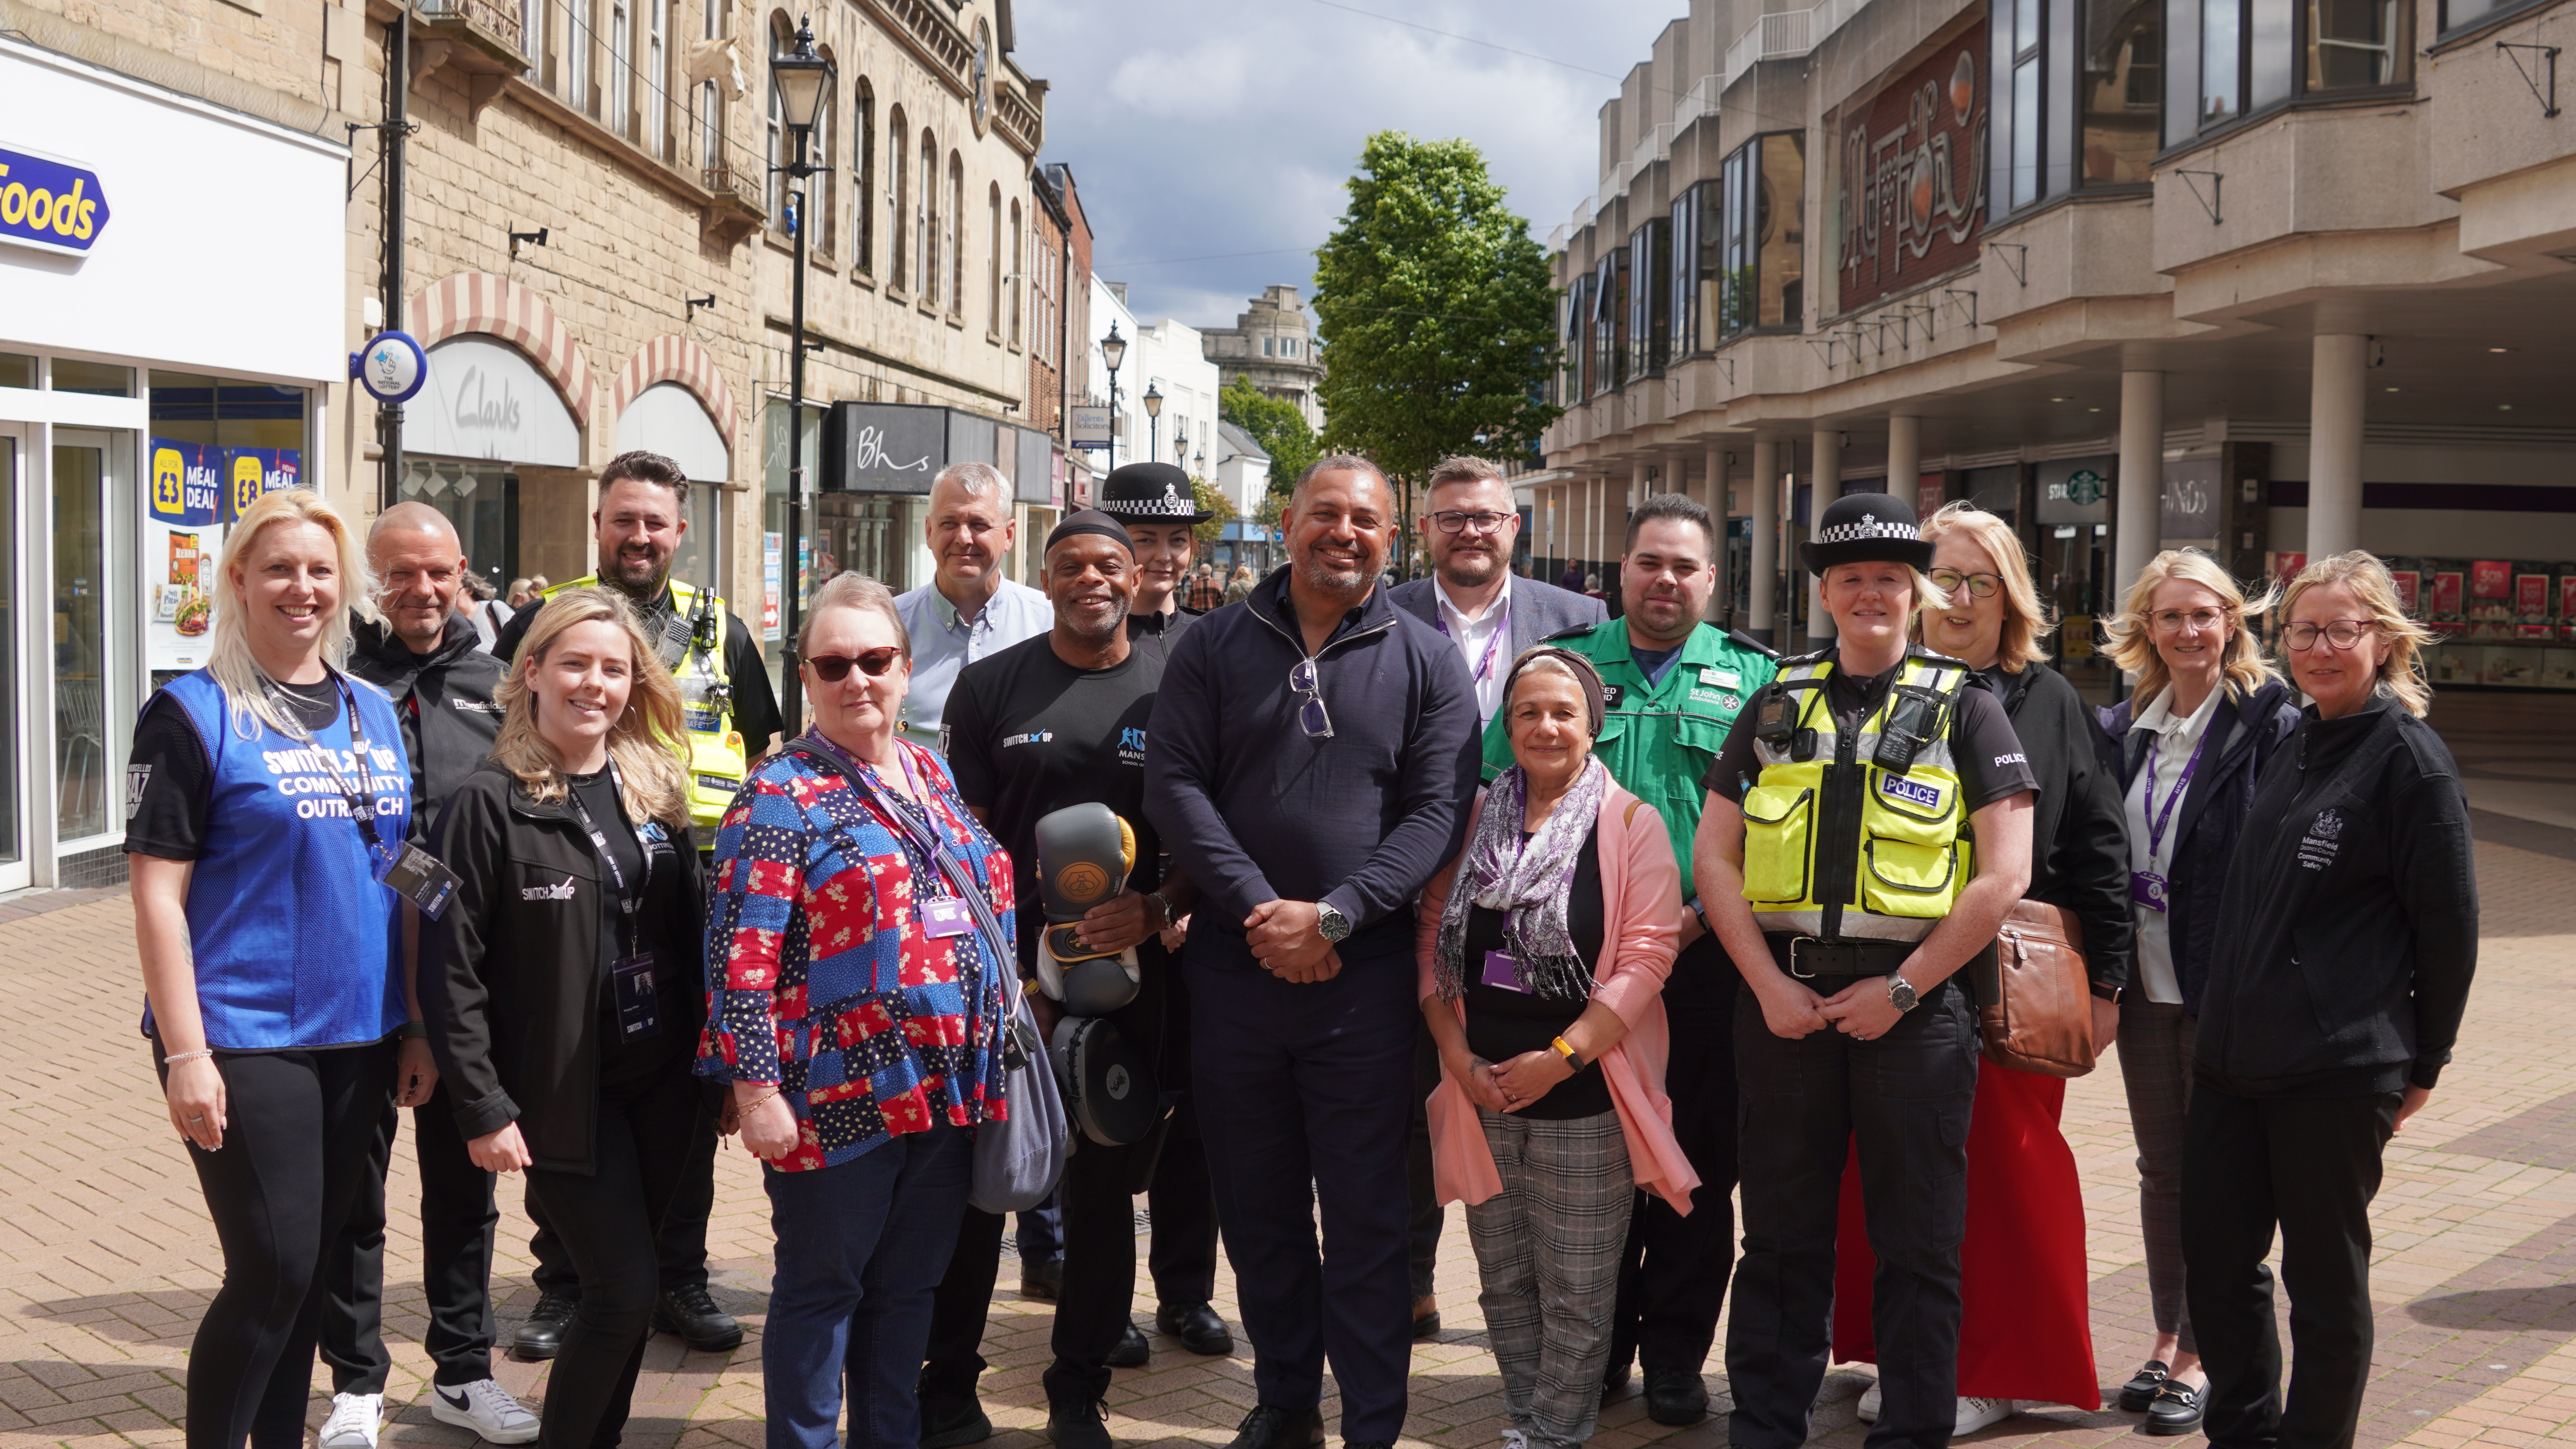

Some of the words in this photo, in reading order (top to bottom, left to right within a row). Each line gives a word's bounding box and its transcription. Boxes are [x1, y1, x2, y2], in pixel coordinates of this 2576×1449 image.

[455, 364, 519, 433] Clarks
[857, 425, 930, 471] Bhs
[159, 459, 167, 468] ALL
[168, 460, 178, 469] FOR
[282, 464, 296, 474] INDIAN
[186, 466, 218, 488] MEAL
[265, 470, 294, 489] MEAL
[158, 471, 179, 504] £3
[237, 479, 258, 508] £8
[2048, 483, 2069, 500] STAR
[186, 487, 215, 509] DEAL
[175, 548, 196, 558] KEBAB
[164, 595, 179, 604] Pittas
[1488, 628, 1503, 652] Councillor
[1473, 660, 1485, 682] Mansfield
[1688, 695, 1719, 705] Ambulance
[1700, 689, 1720, 700] John
[814, 730, 835, 752] Councillor
[935, 731, 950, 759] AZ
[1003, 733, 1029, 748] SWITCH
[1042, 732, 1053, 742] UP
[370, 748, 398, 771] UP
[1118, 750, 1145, 761] MANS
[1994, 753, 2027, 767] POLICE
[126, 772, 150, 803] BAZ
[1887, 778, 1936, 803] POLICE
[2174, 777, 2187, 794] Staff
[297, 797, 403, 819] OUTRCH
[2157, 814, 2169, 839] Mansfield
[2302, 836, 2339, 851] Mansfield
[2318, 847, 2336, 857] Council
[2297, 852, 2333, 866] Community
[2302, 861, 2323, 871] Safety
[428, 893, 444, 912] SWITCH
[444, 880, 453, 890] UP
[522, 887, 549, 900] SWITCH
[564, 886, 574, 900] UP
[621, 901, 632, 910] BAZ
[626, 1021, 643, 1034] SWITCH
[647, 1017, 653, 1026] UP
